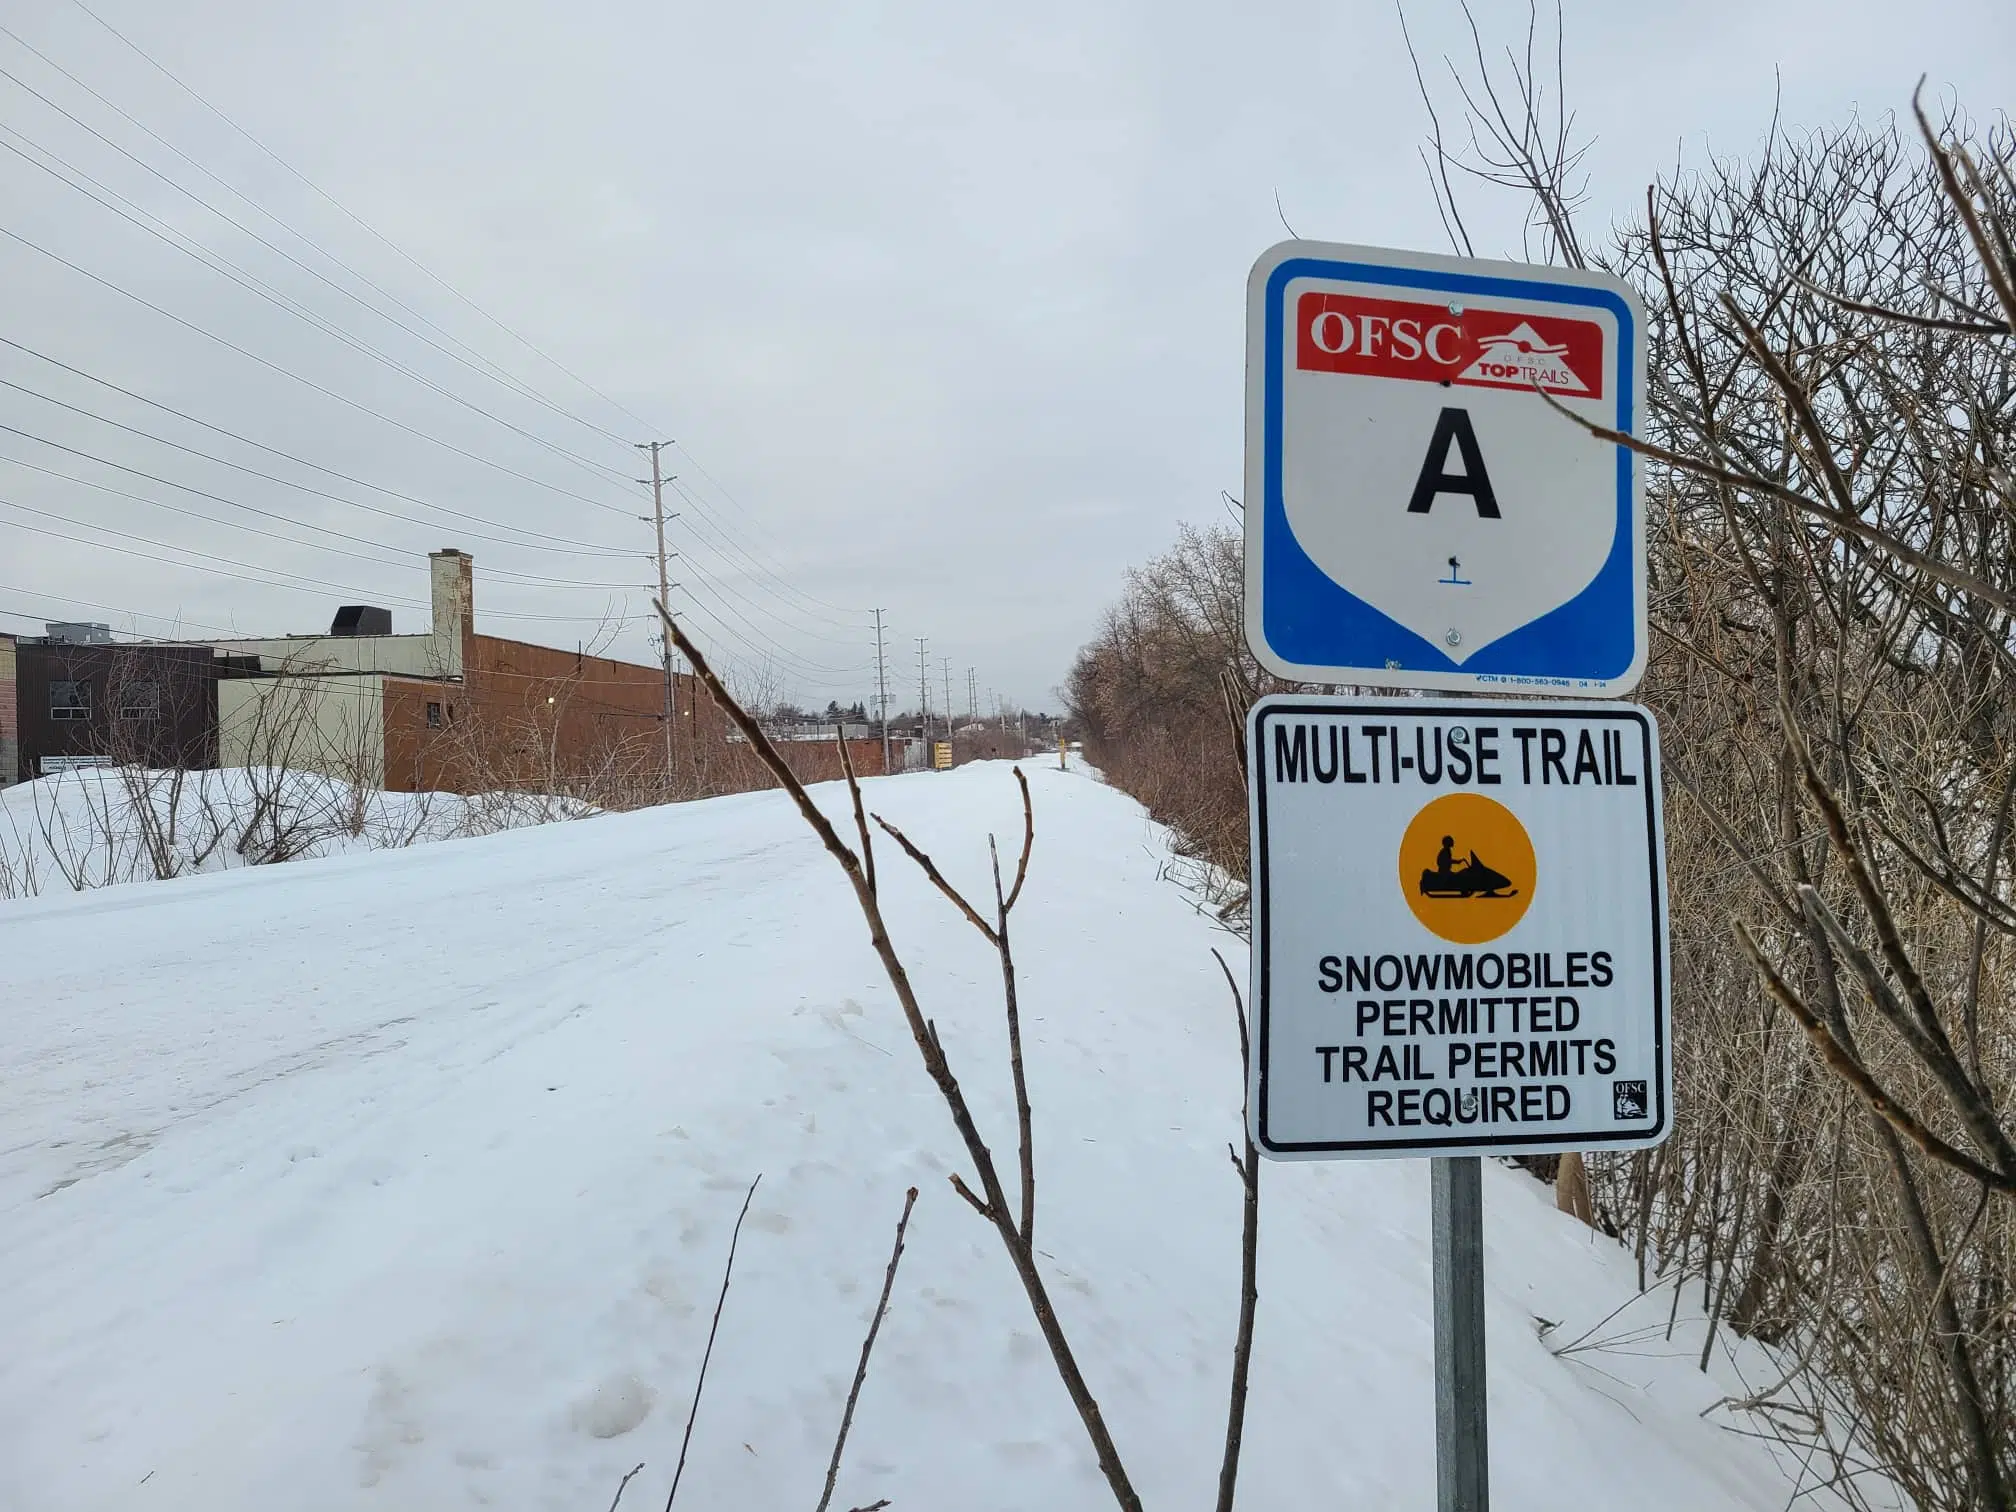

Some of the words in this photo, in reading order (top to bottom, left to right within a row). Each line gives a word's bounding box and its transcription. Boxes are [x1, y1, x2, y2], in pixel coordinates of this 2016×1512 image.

[1310, 311, 1465, 365] OFSC
[1407, 407, 1502, 520] A
[1274, 724, 1502, 785] MULTI-USE
[1512, 727, 1637, 786] TRAIL
[1318, 951, 1614, 993] SNOWMOBILES
[1356, 996, 1580, 1037] PERMITTED
[1315, 1044, 1435, 1083] TRAIL
[1448, 1038, 1617, 1080] PERMITS
[1367, 1084, 1571, 1128] REQUIRED
[1615, 1082, 1646, 1094] OFSC
